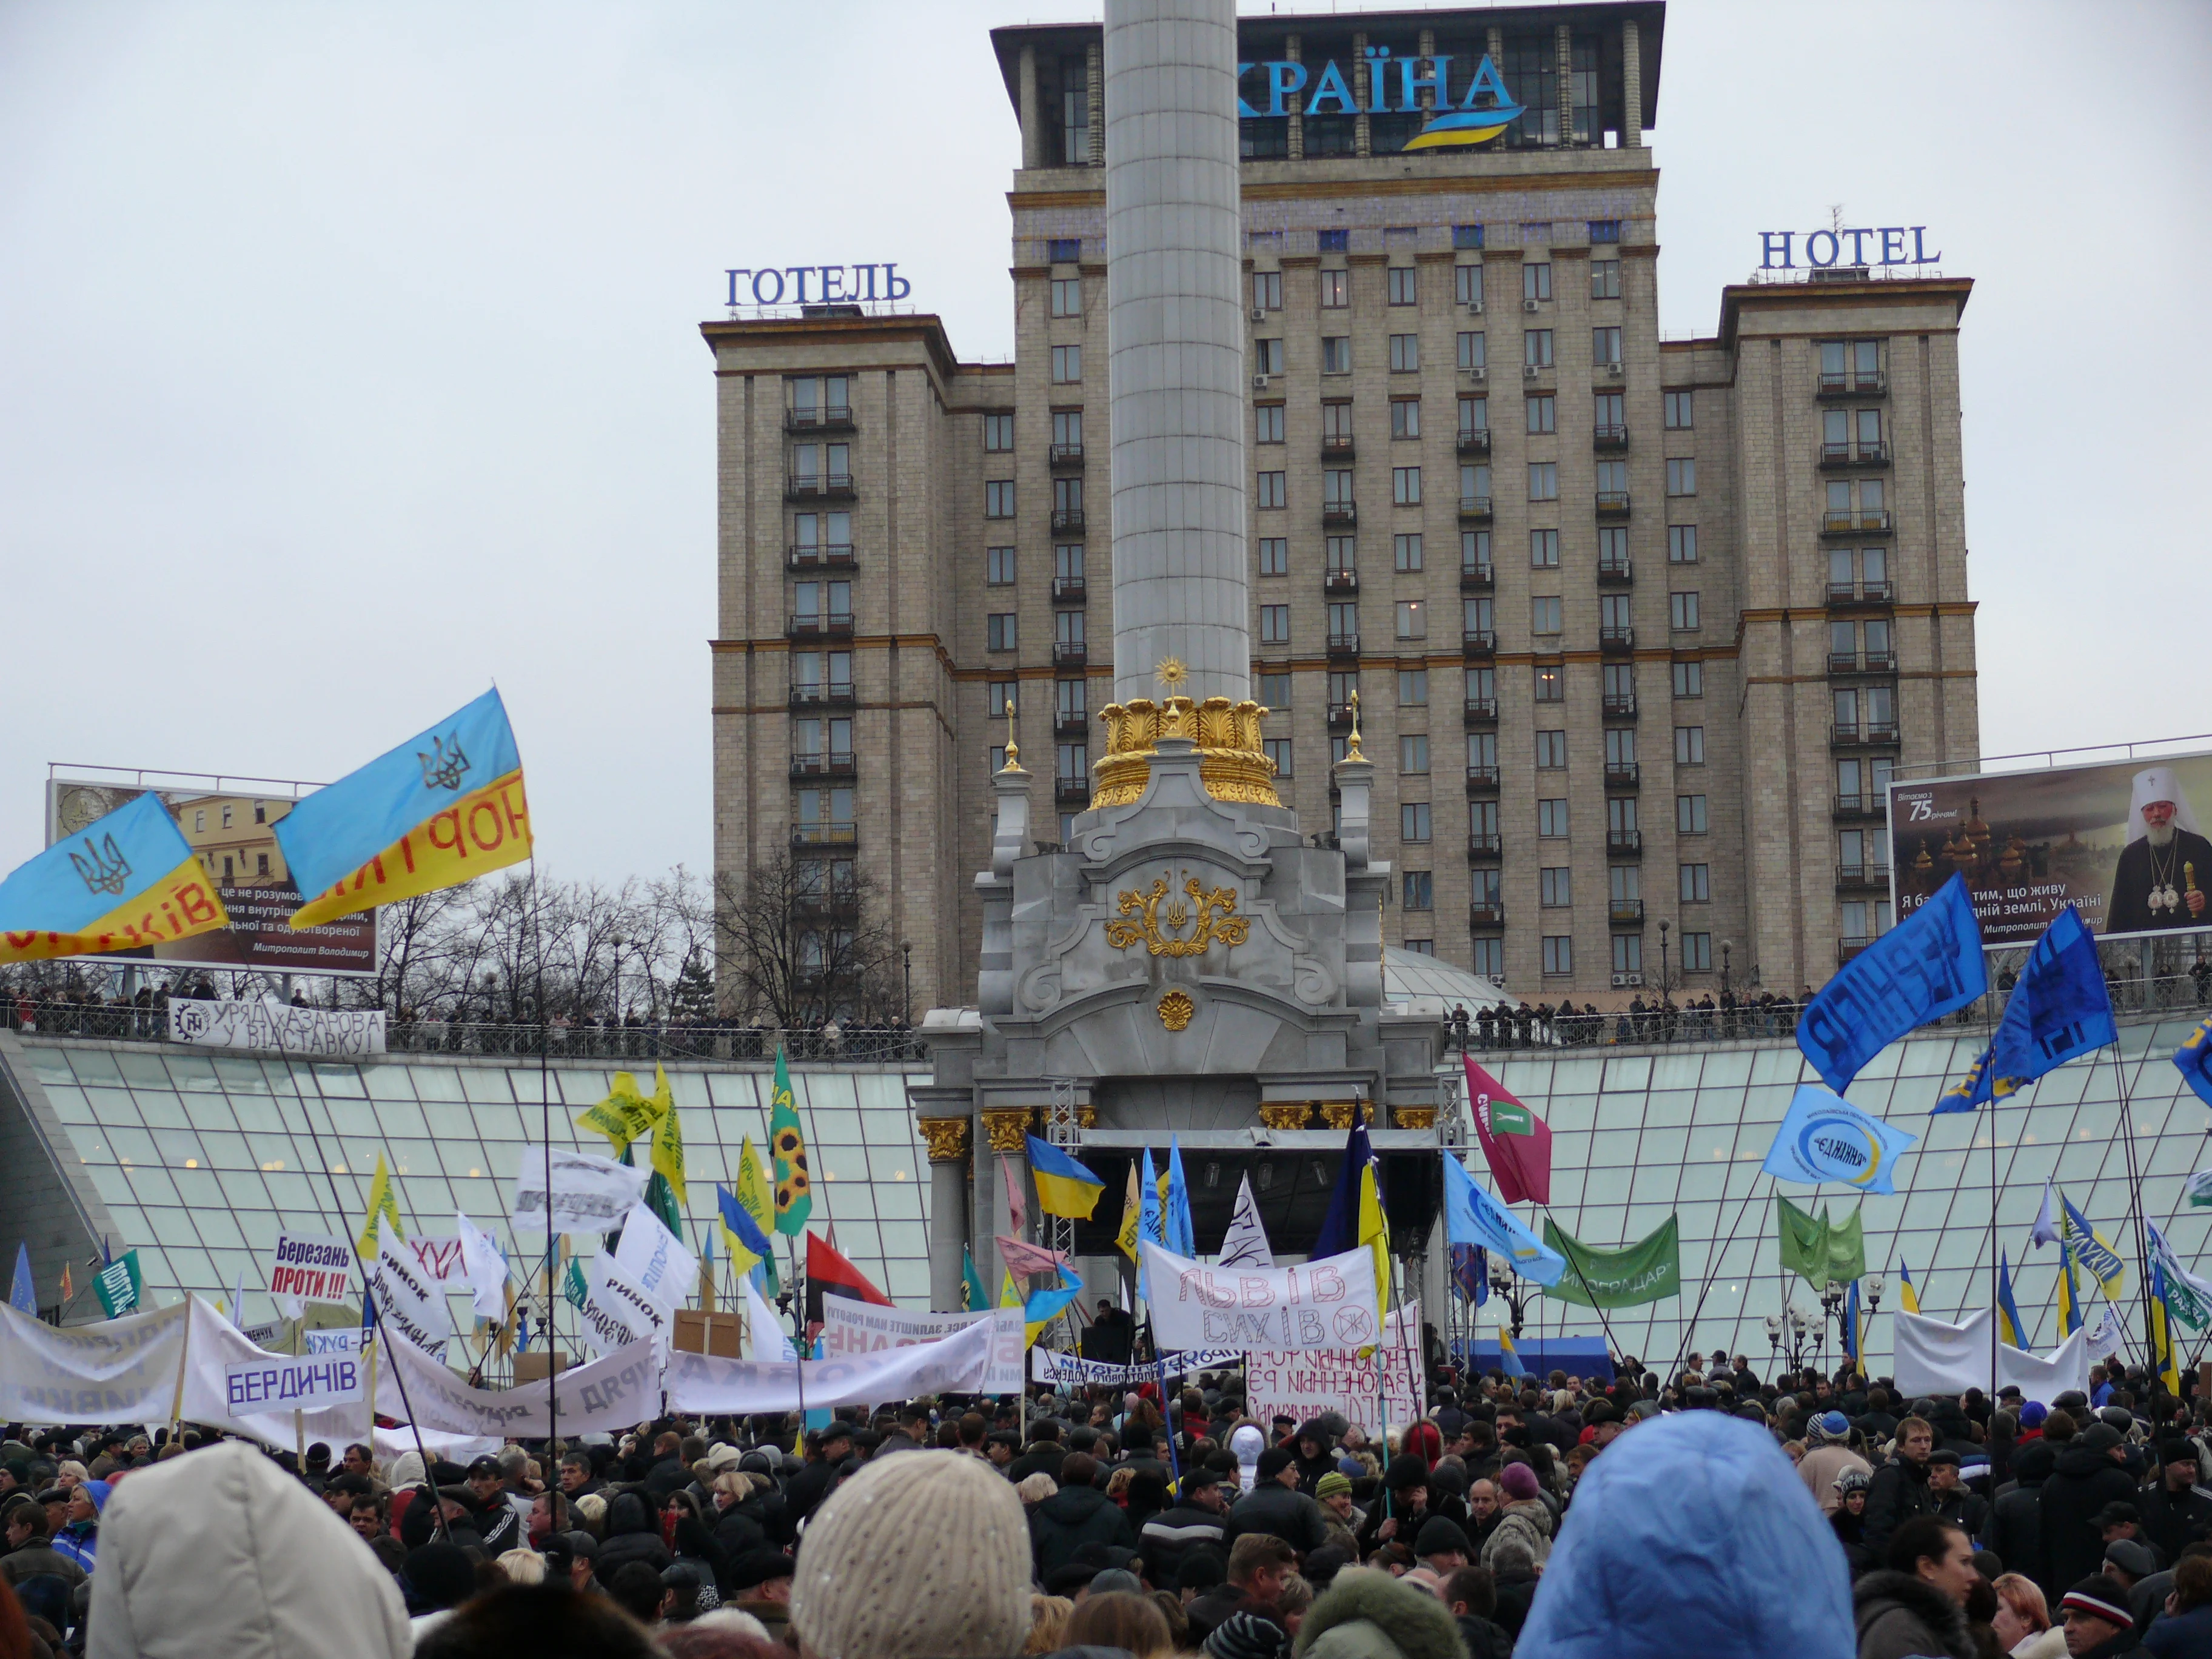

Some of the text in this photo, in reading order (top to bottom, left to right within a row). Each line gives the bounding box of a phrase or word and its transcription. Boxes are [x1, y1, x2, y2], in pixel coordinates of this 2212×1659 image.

[1238, 45, 1518, 118] КРАЇНА
[1758, 226, 1942, 269] HOTEL
[725, 263, 911, 306] ГОТЕЛЬ
[1897, 793, 1927, 802] Вітаємо
[222, 888, 303, 902] це не розумов
[1902, 896, 1910, 908] Я
[1972, 890, 2002, 902] тим,
[2007, 887, 2026, 899] що
[2030, 884, 2065, 897] живу
[249, 905, 297, 917] внутріш
[2004, 900, 2046, 915] землі,
[223, 920, 260, 931] ільної
[262, 922, 273, 931] та
[1983, 922, 2048, 934] Митрополит
[253, 942, 369, 959] Митрополит Володимир
[214, 1003, 266, 1025] УРЯД
[276, 1236, 350, 1267] Березань
[271, 1267, 327, 1298] ПРОТИ
[381, 1250, 429, 1302] РИНОК
[606, 1278, 664, 1328] РИНОК
[228, 1360, 357, 1404] БЕРДИЧІВ
